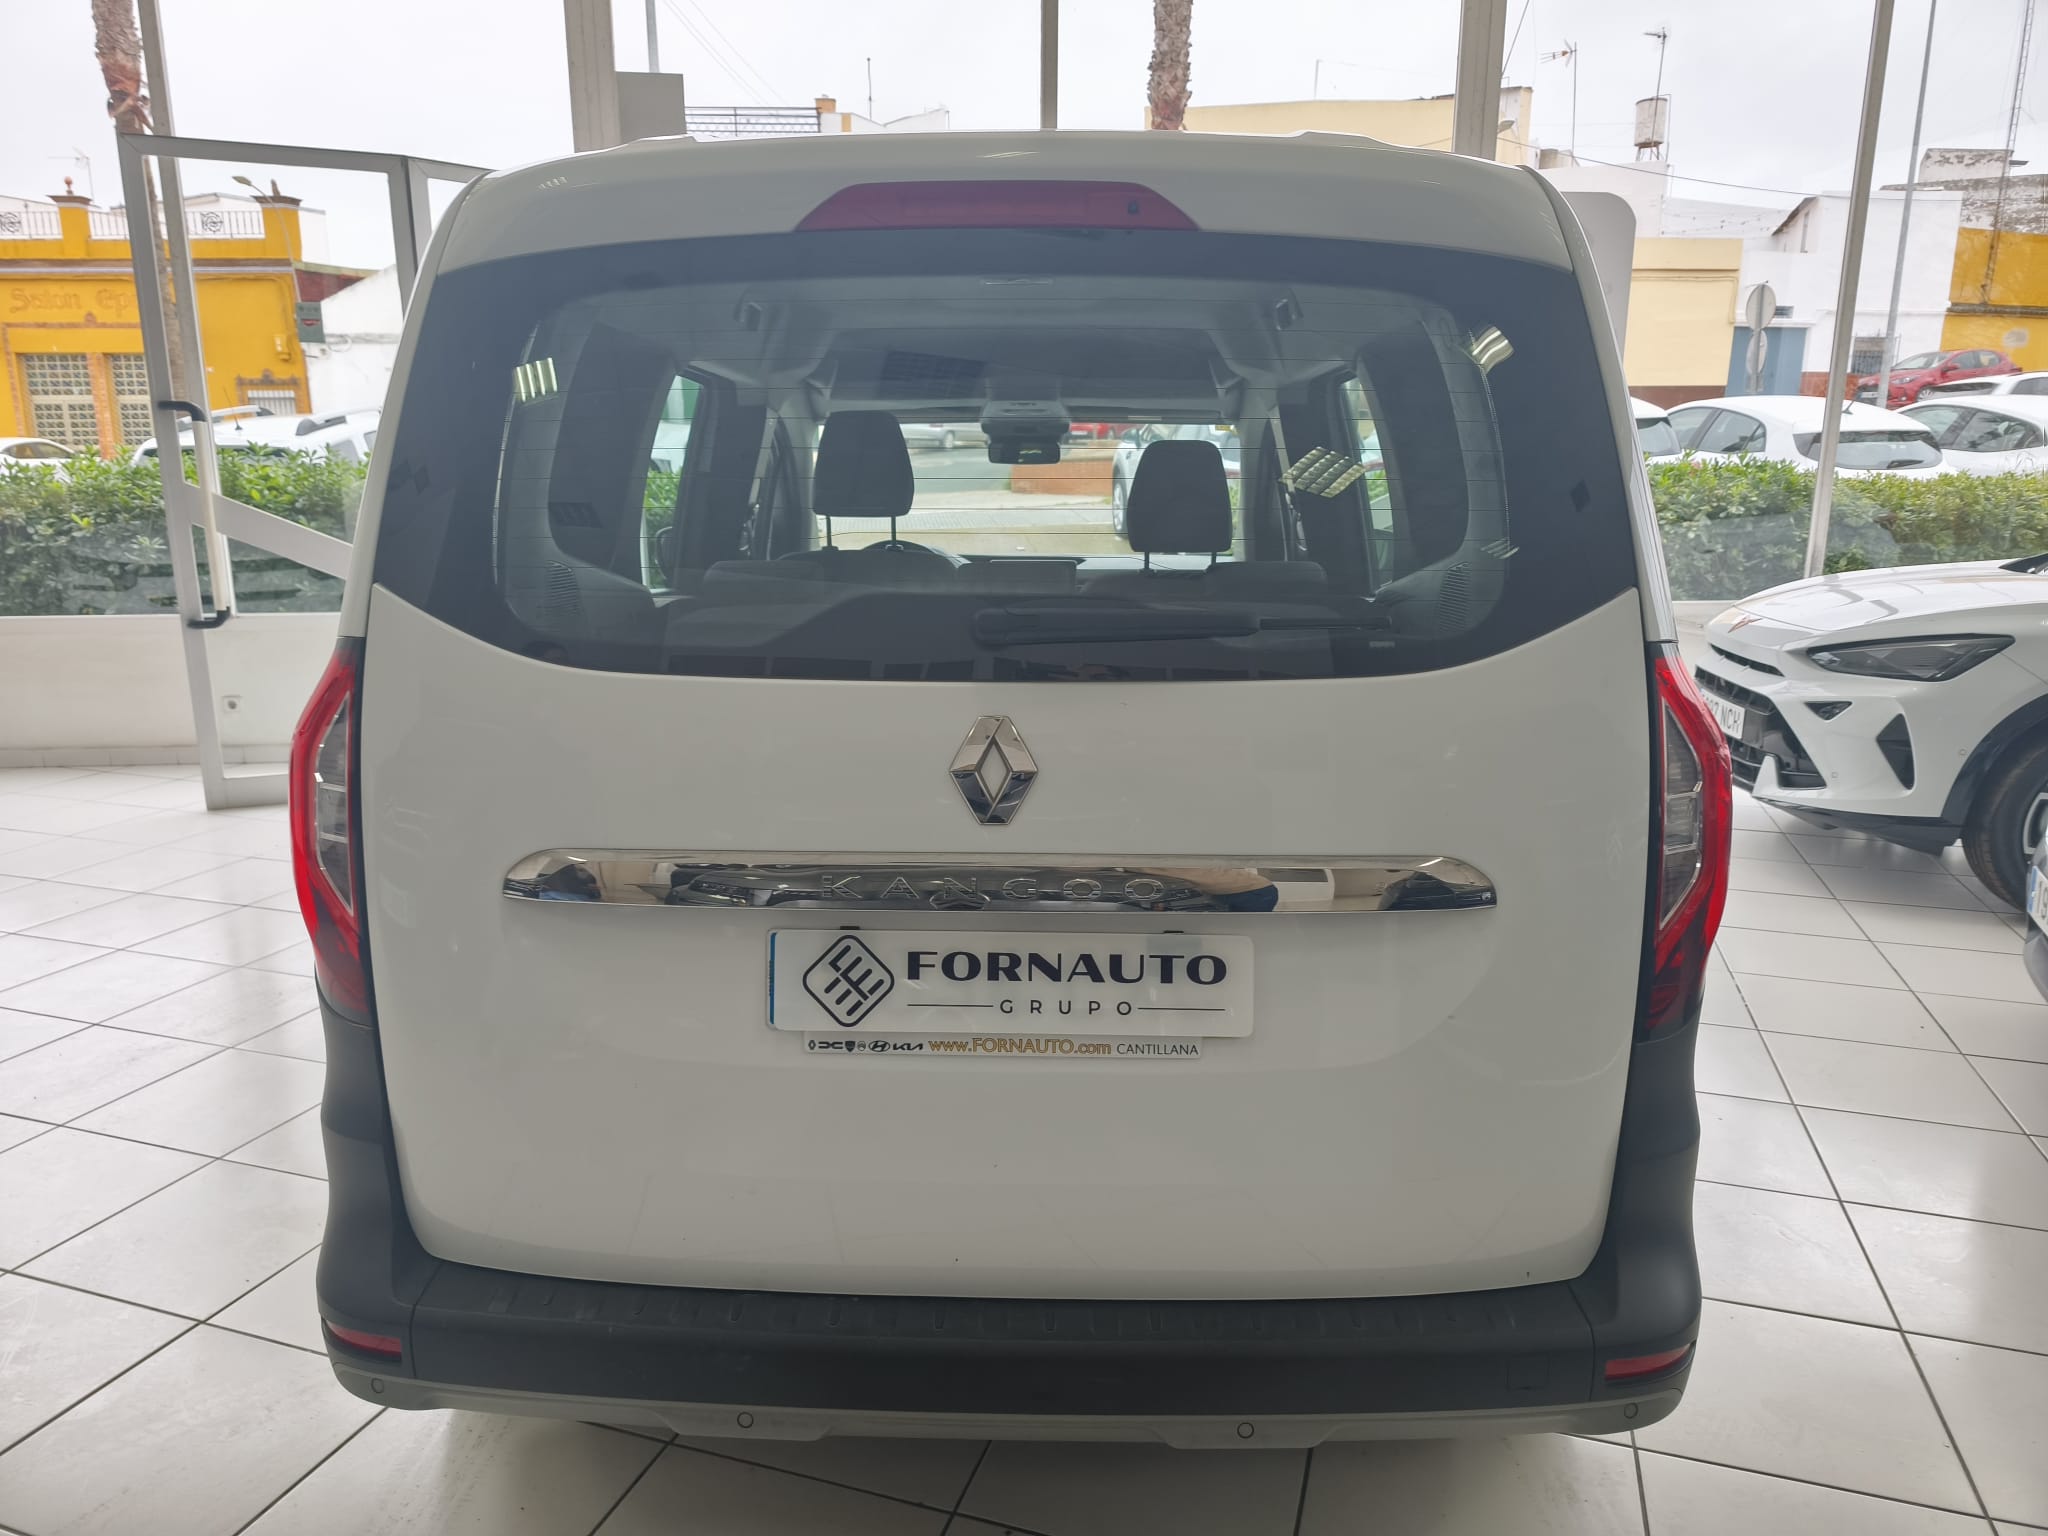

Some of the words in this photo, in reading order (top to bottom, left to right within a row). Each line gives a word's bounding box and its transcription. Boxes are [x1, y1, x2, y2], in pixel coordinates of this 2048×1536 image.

[822, 875, 1165, 901] KANGOO
[907, 951, 1228, 986] FORNAUTO
[1000, 999, 1133, 1016] GRUPO
[928, 1037, 1112, 1055] www.FORNAUTO.com
[1116, 1043, 1199, 1056] CANTILLANA
